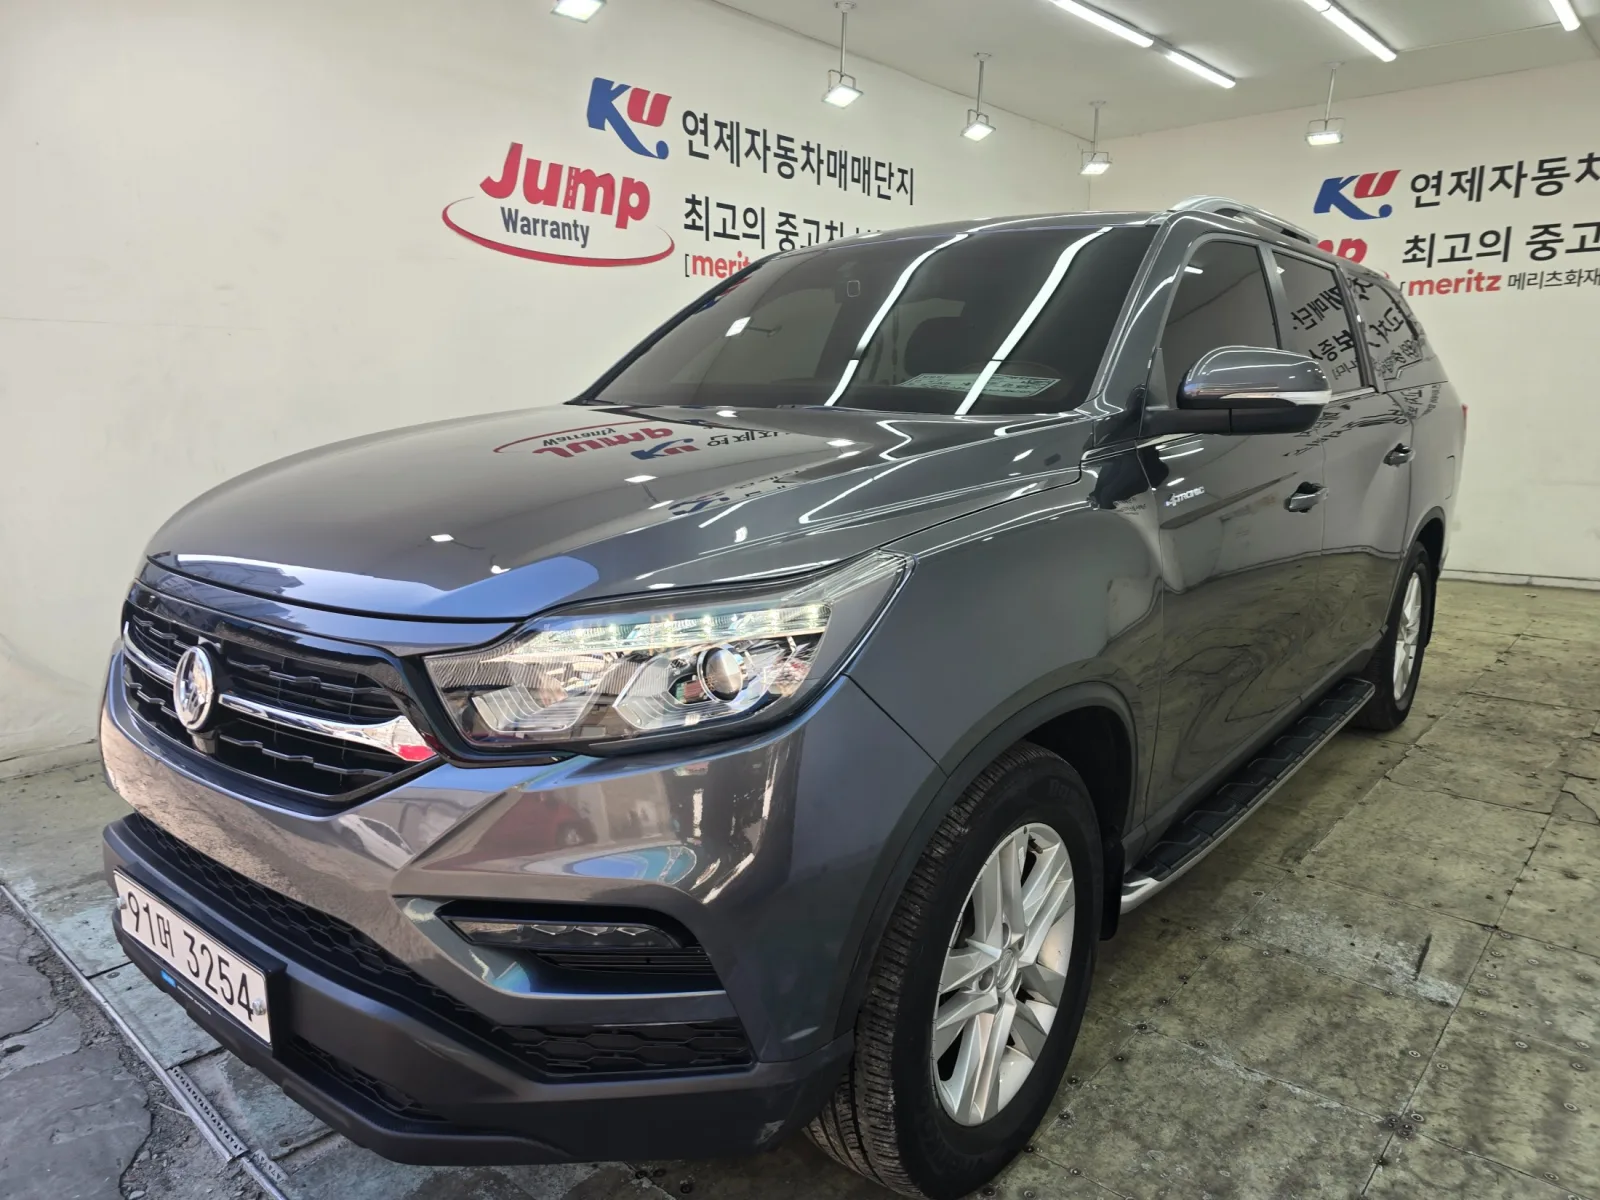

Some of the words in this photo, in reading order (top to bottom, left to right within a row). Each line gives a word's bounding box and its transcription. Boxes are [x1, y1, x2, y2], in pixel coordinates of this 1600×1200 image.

[479, 141, 650, 229] Jump
[682, 110, 913, 206] 연제자동차매매단지
[500, 206, 590, 248] Warranty
[684, 193, 765, 250] 최고의
[1402, 226, 1512, 268] 최고의
[1507, 267, 1600, 291] 메리츠화재
[127, 891, 175, 958] 91머
[183, 929, 254, 1022] 3254
